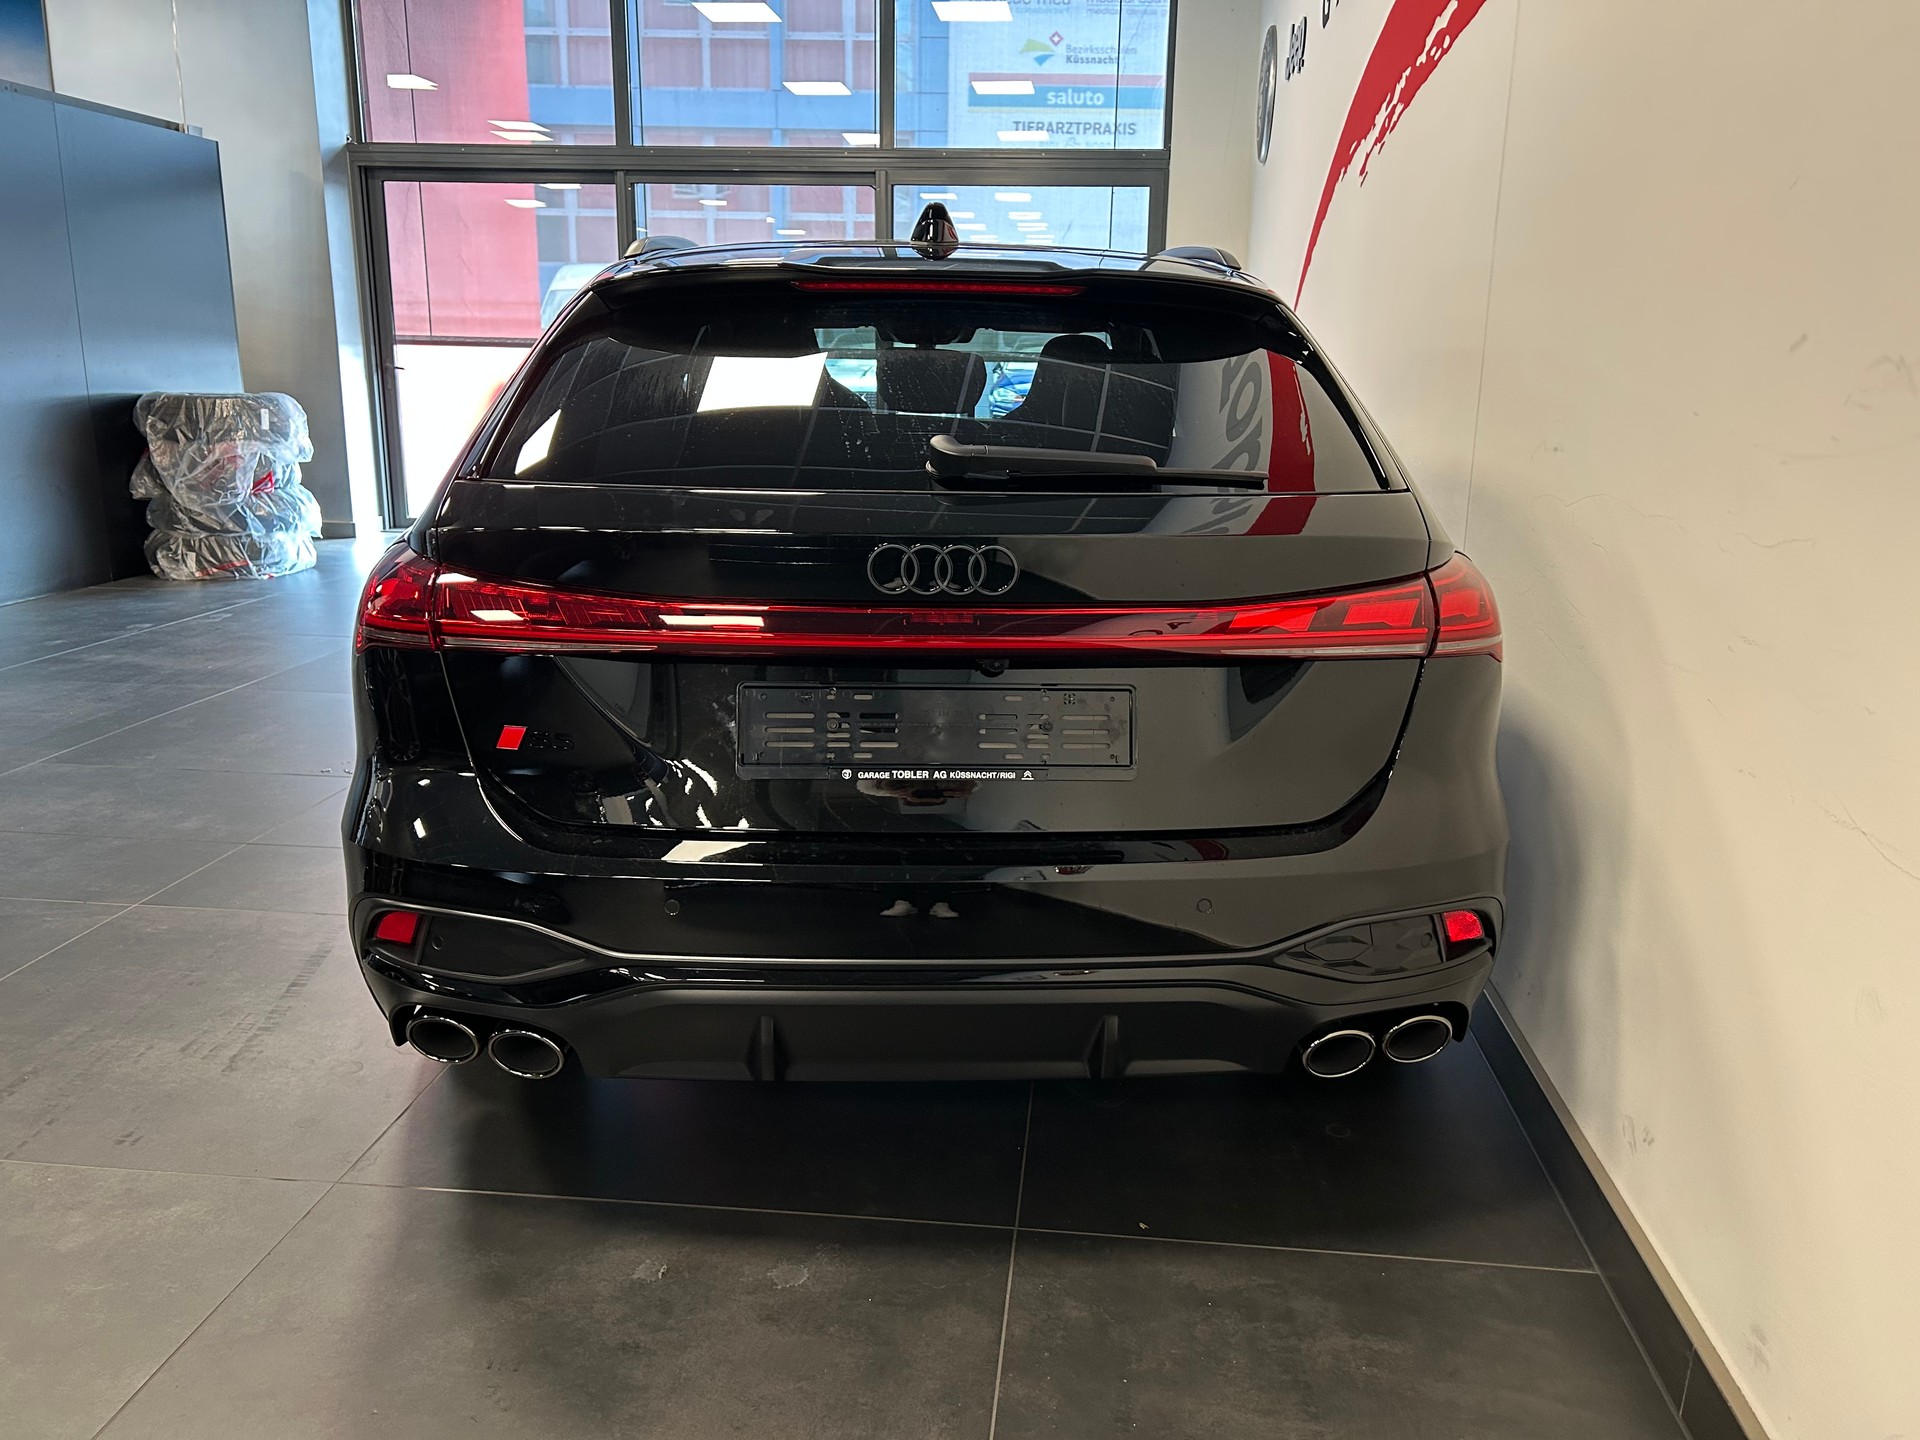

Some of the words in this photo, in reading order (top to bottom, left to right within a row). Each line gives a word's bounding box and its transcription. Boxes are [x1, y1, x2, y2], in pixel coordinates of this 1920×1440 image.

[1046, 88, 1105, 106] saluto
[1012, 120, 1137, 136] TIERARZTPRAXIS
[857, 771, 890, 779] GARAGE
[892, 770, 929, 779] TOBLER
[933, 770, 948, 779] AG
